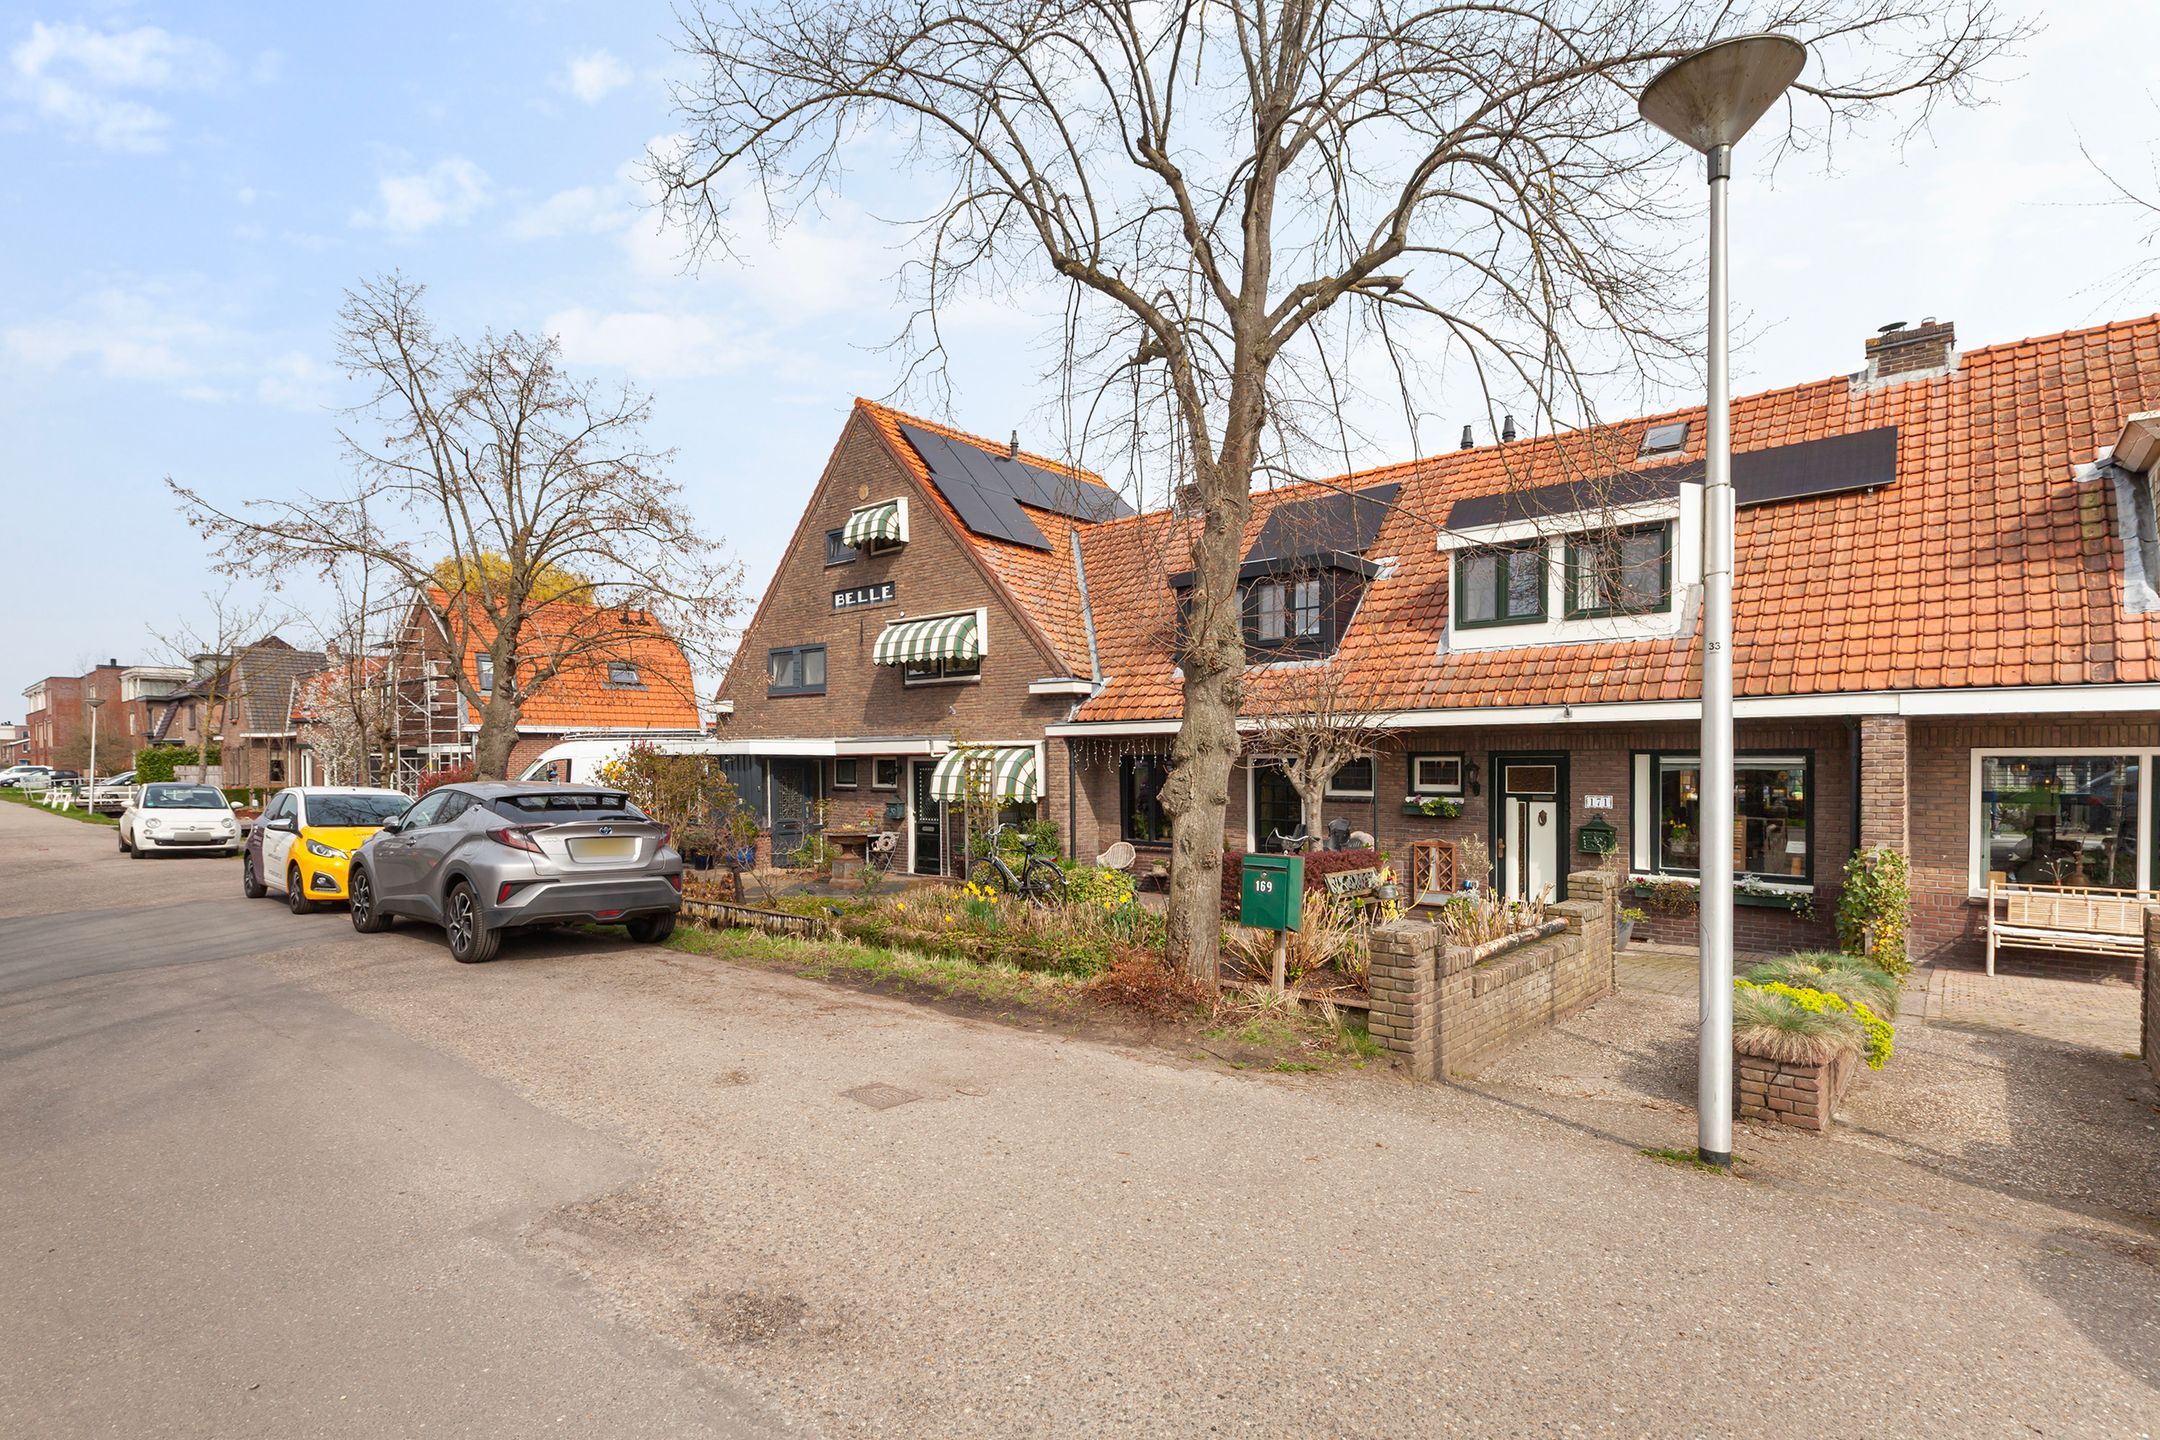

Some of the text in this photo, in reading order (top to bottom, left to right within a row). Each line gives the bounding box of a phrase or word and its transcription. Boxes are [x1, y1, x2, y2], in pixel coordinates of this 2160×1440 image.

[834, 585, 894, 607] BELLE
[1590, 797, 1608, 807] 171
[1255, 880, 1273, 893] 169
